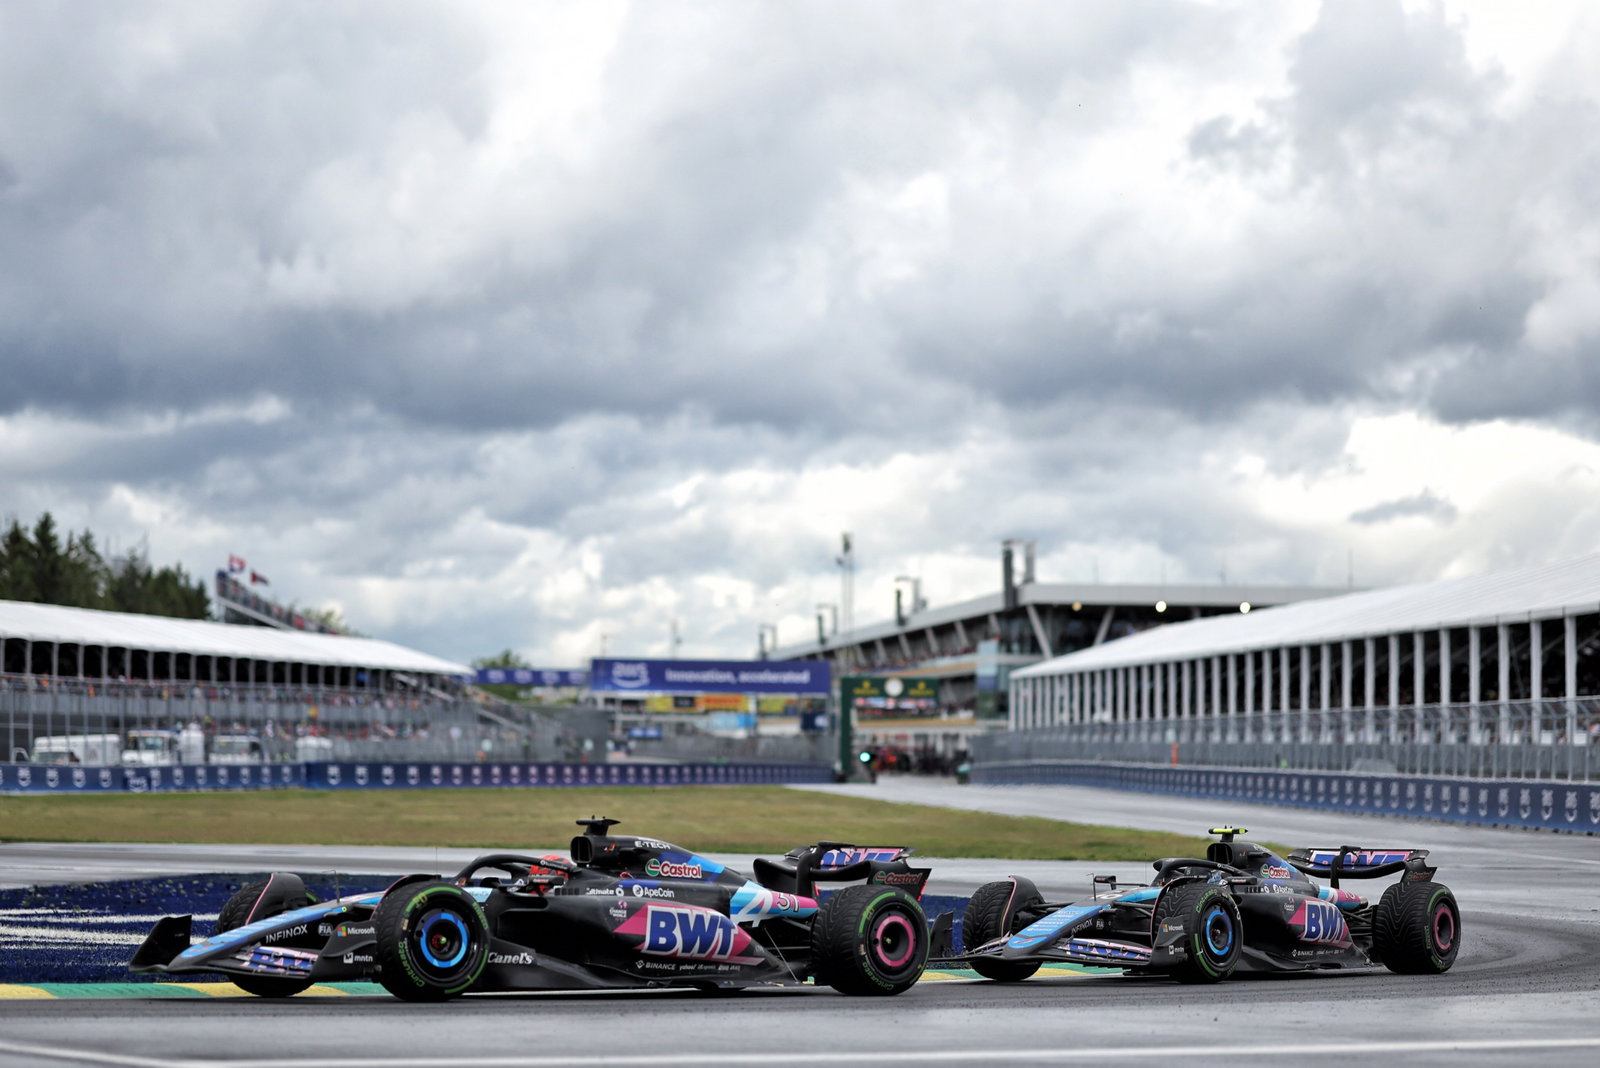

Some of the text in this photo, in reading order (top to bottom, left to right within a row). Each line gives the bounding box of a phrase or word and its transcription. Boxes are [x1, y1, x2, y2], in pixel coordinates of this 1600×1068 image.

[665, 669, 810, 684] Innovation, accelerated
[634, 840, 671, 850] E-TECH
[660, 862, 702, 878] Castrol
[1268, 866, 1291, 878] Castrol
[885, 872, 922, 884] Castrol
[644, 887, 675, 898] ApeCoin
[265, 924, 308, 943] INFINOX
[318, 924, 332, 935] FIA
[347, 926, 375, 935] Microsoft
[642, 905, 738, 960] BWT
[354, 954, 373, 962] mntn
[487, 952, 533, 964] Canel's
[398, 941, 425, 988] Cinturato
[645, 961, 677, 971] BINANCE
